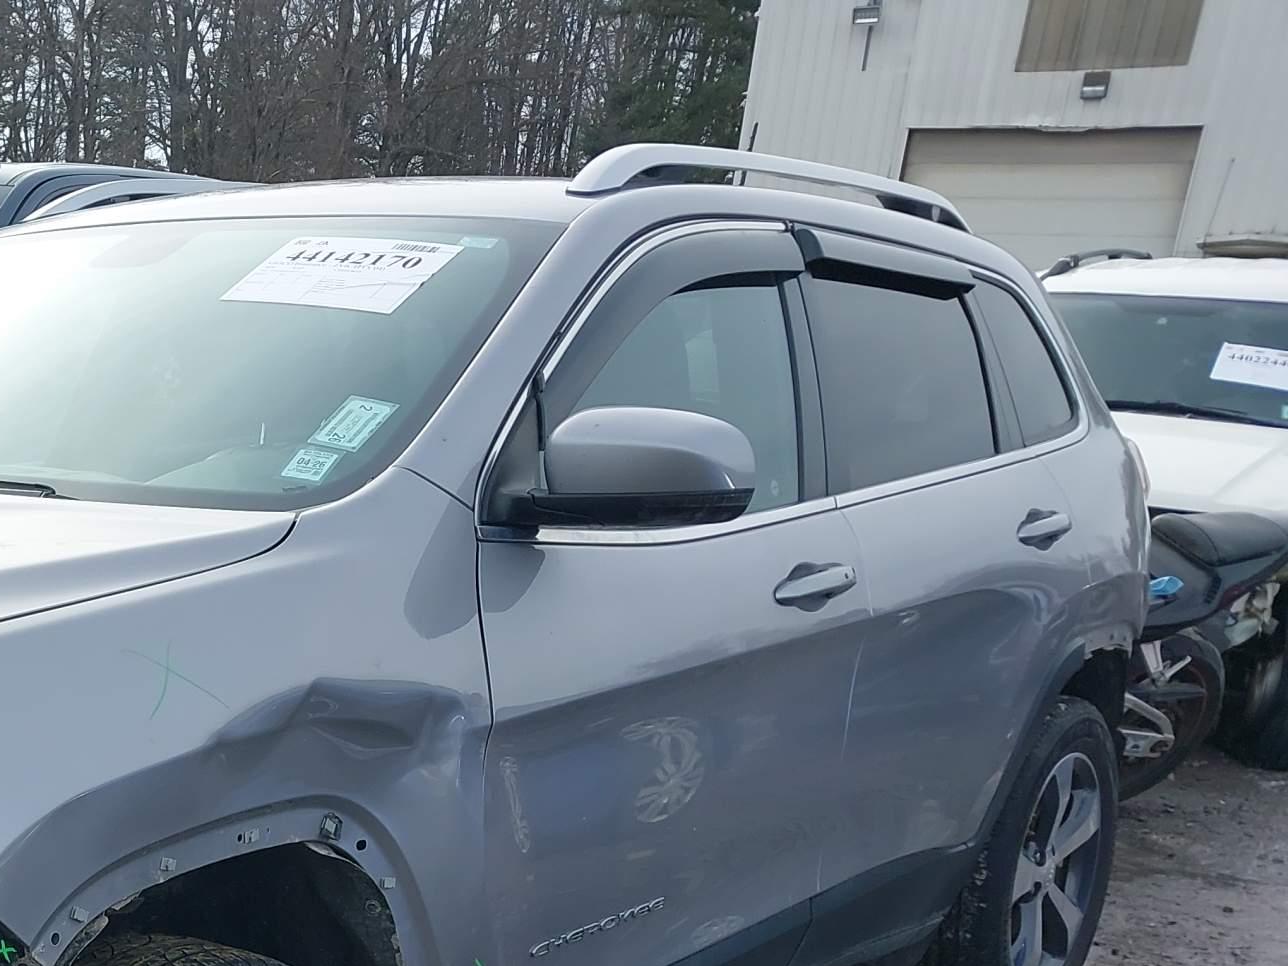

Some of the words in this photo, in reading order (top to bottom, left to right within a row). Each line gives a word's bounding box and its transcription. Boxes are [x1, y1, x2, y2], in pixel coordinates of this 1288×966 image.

[286, 249, 423, 269] 44142170
[1227, 352, 1288, 367] 4402244
[529, 896, 665, 957] CHEROKEE
